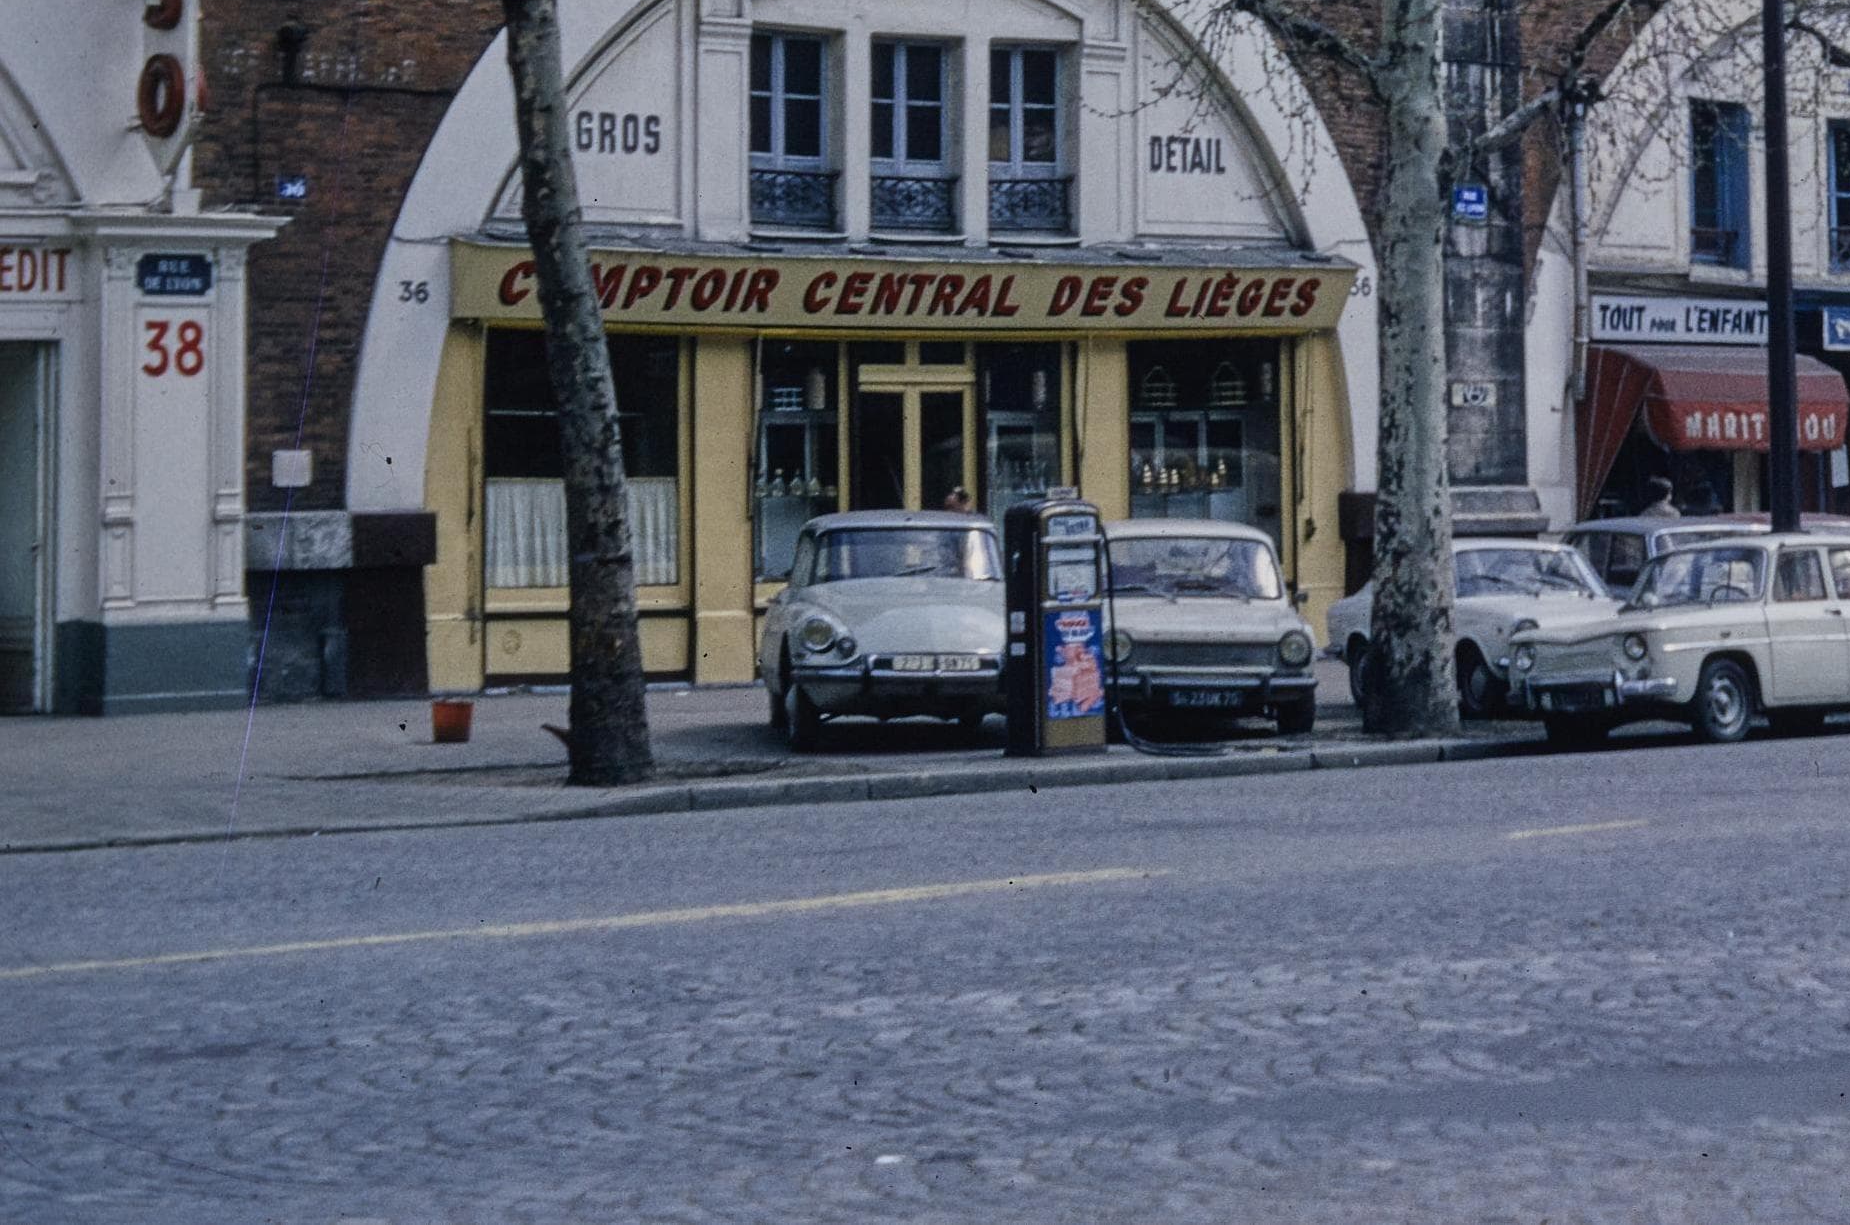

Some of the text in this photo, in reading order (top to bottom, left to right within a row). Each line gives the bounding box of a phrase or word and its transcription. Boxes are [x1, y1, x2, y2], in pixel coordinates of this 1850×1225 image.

[577, 110, 660, 155] GROS
[399, 281, 430, 303] 36
[499, 260, 781, 313] CMPTOIR
[803, 270, 1020, 318] CENTRAL
[1046, 275, 1149, 318] DES
[1600, 305, 1646, 332] TOUT
[1685, 306, 1769, 334] L'ENFANT
[143, 320, 204, 378] 38
[1685, 411, 1836, 441] MARITOU
